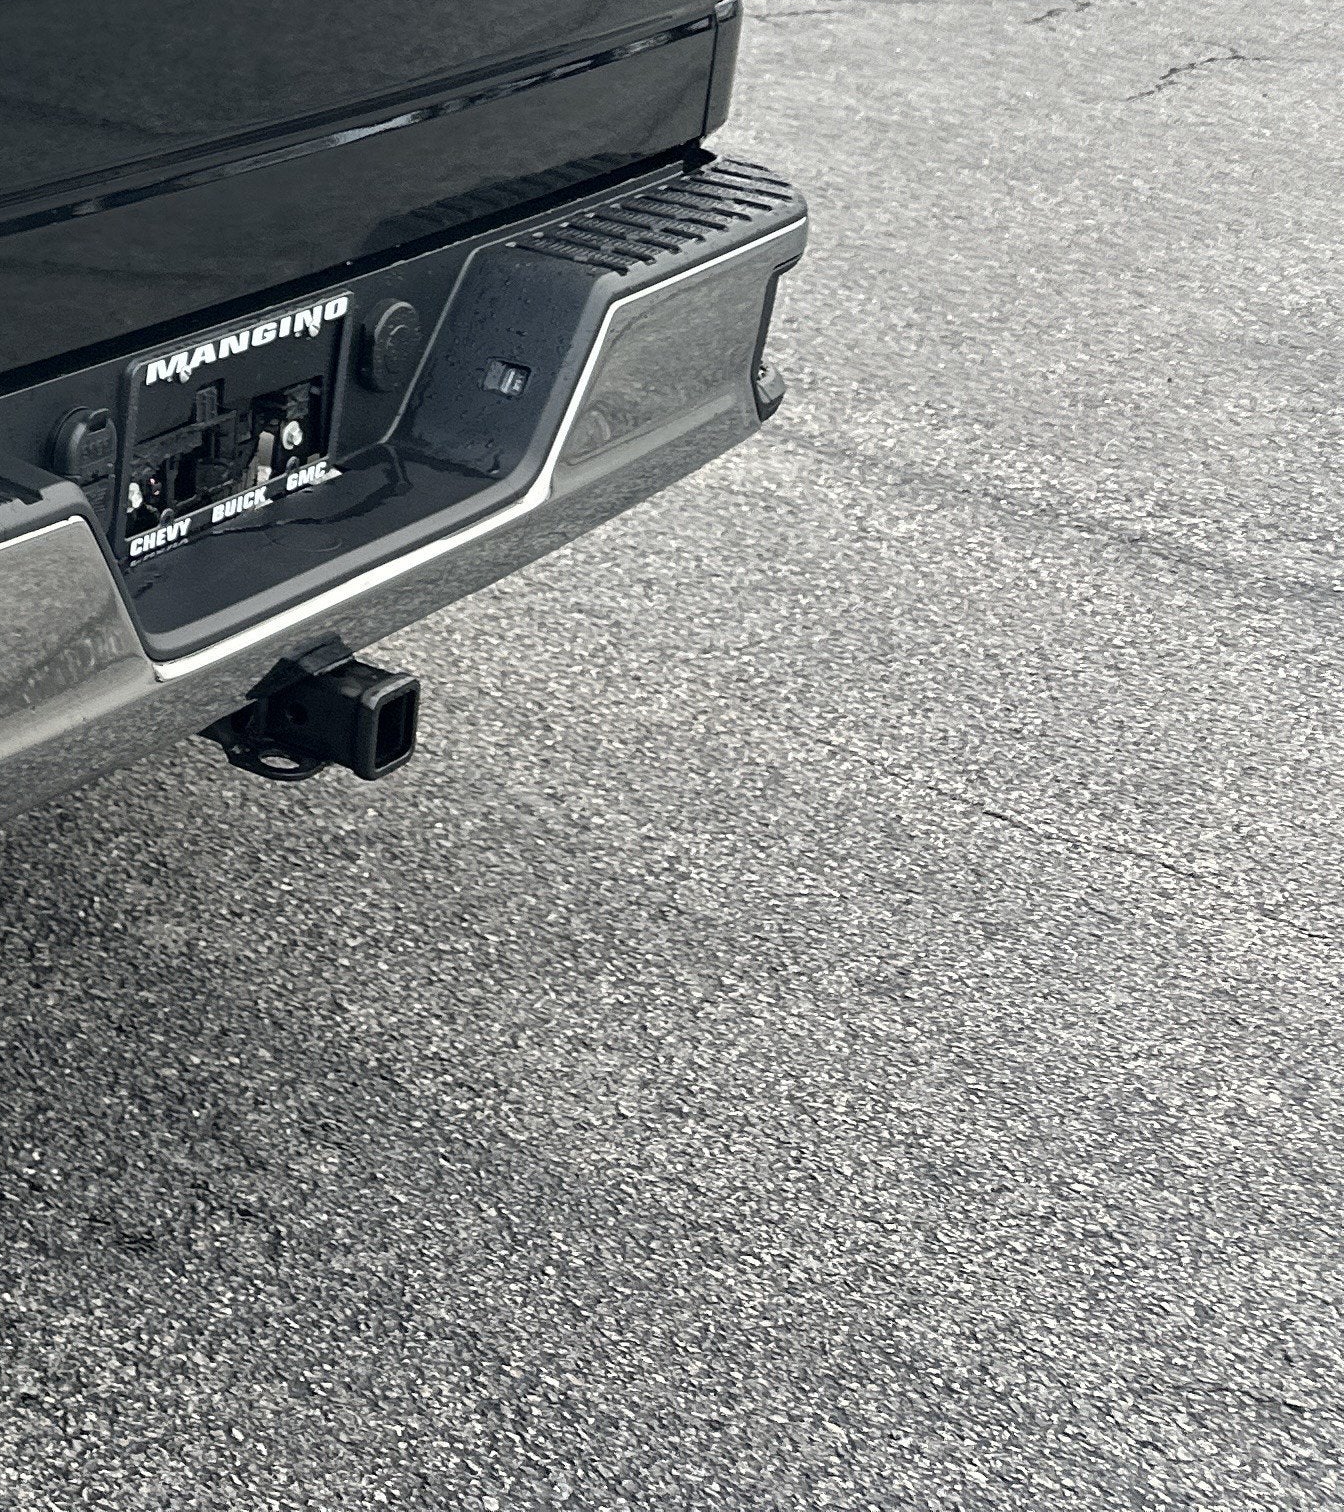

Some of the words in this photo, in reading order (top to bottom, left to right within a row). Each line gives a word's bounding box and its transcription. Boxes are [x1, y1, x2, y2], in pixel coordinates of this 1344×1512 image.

[145, 296, 349, 386] MANGINO
[129, 517, 192, 557] CHEVY
[211, 486, 268, 524] BUICK
[286, 461, 327, 491] GMC
